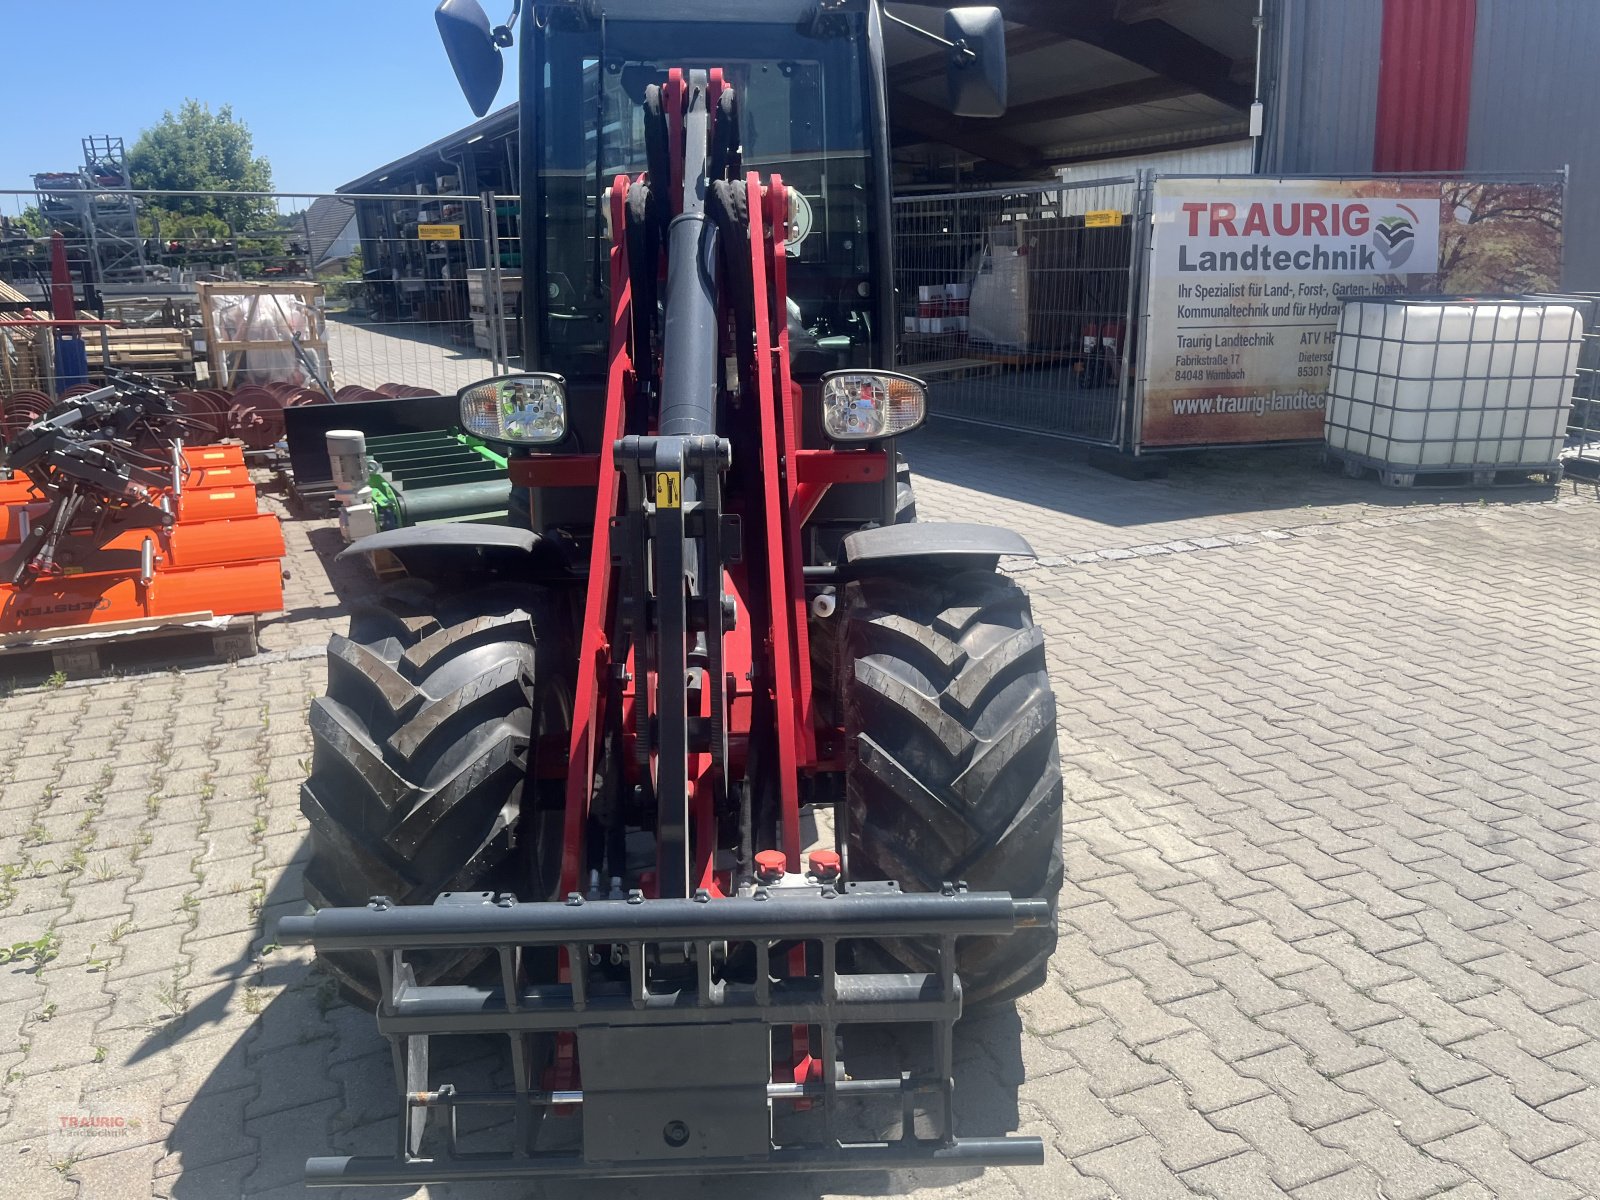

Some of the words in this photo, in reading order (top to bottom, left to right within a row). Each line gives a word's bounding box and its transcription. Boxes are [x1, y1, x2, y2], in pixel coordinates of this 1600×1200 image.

[1182, 202, 1370, 237] TRAURIG
[1178, 244, 1376, 271] Landtechnik
[1178, 283, 1193, 298] Ihr
[1194, 282, 1245, 301] Spezialist
[1248, 282, 1263, 297] für
[1264, 282, 1295, 298] Land-,
[1298, 282, 1329, 298] Forst-,
[1177, 302, 1269, 319] Kommunaltechnik
[1271, 302, 1290, 317] und
[1293, 302, 1306, 316] für
[1177, 334, 1212, 350] Traurig
[1214, 332, 1274, 348] Landtechnik
[1300, 332, 1321, 345] ATV
[1176, 354, 1228, 367] Fabrikstraße
[1230, 354, 1241, 365] 17
[1175, 370, 1204, 381] 84048
[1205, 368, 1245, 381] Wambach
[1297, 366, 1324, 377] 85301
